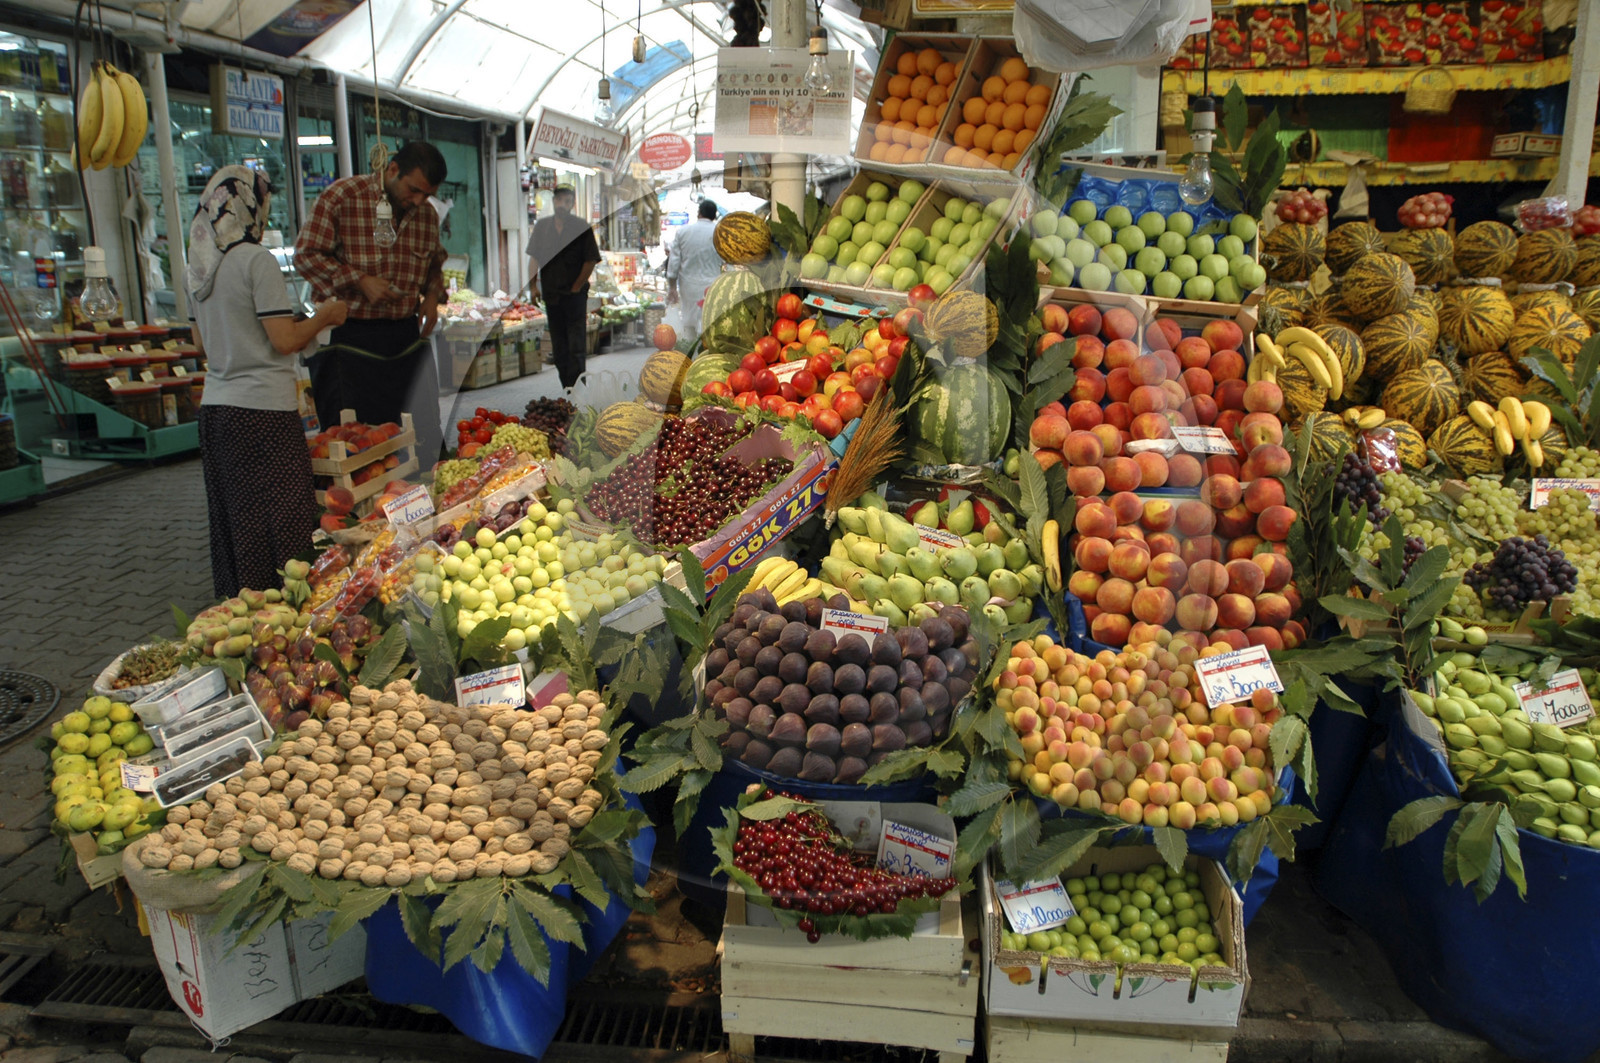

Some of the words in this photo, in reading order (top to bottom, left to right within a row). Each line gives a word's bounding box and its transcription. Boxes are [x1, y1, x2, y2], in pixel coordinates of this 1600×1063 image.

[720, 88, 766, 97] Türkiye'nin
[769, 89, 780, 97] en
[783, 88, 794, 98] iyi
[798, 88, 809, 97] 10
[538, 123, 579, 150] BEYOĞLU
[790, 483, 801, 495] 27
[785, 486, 812, 521] 27
[751, 517, 762, 530] 27
